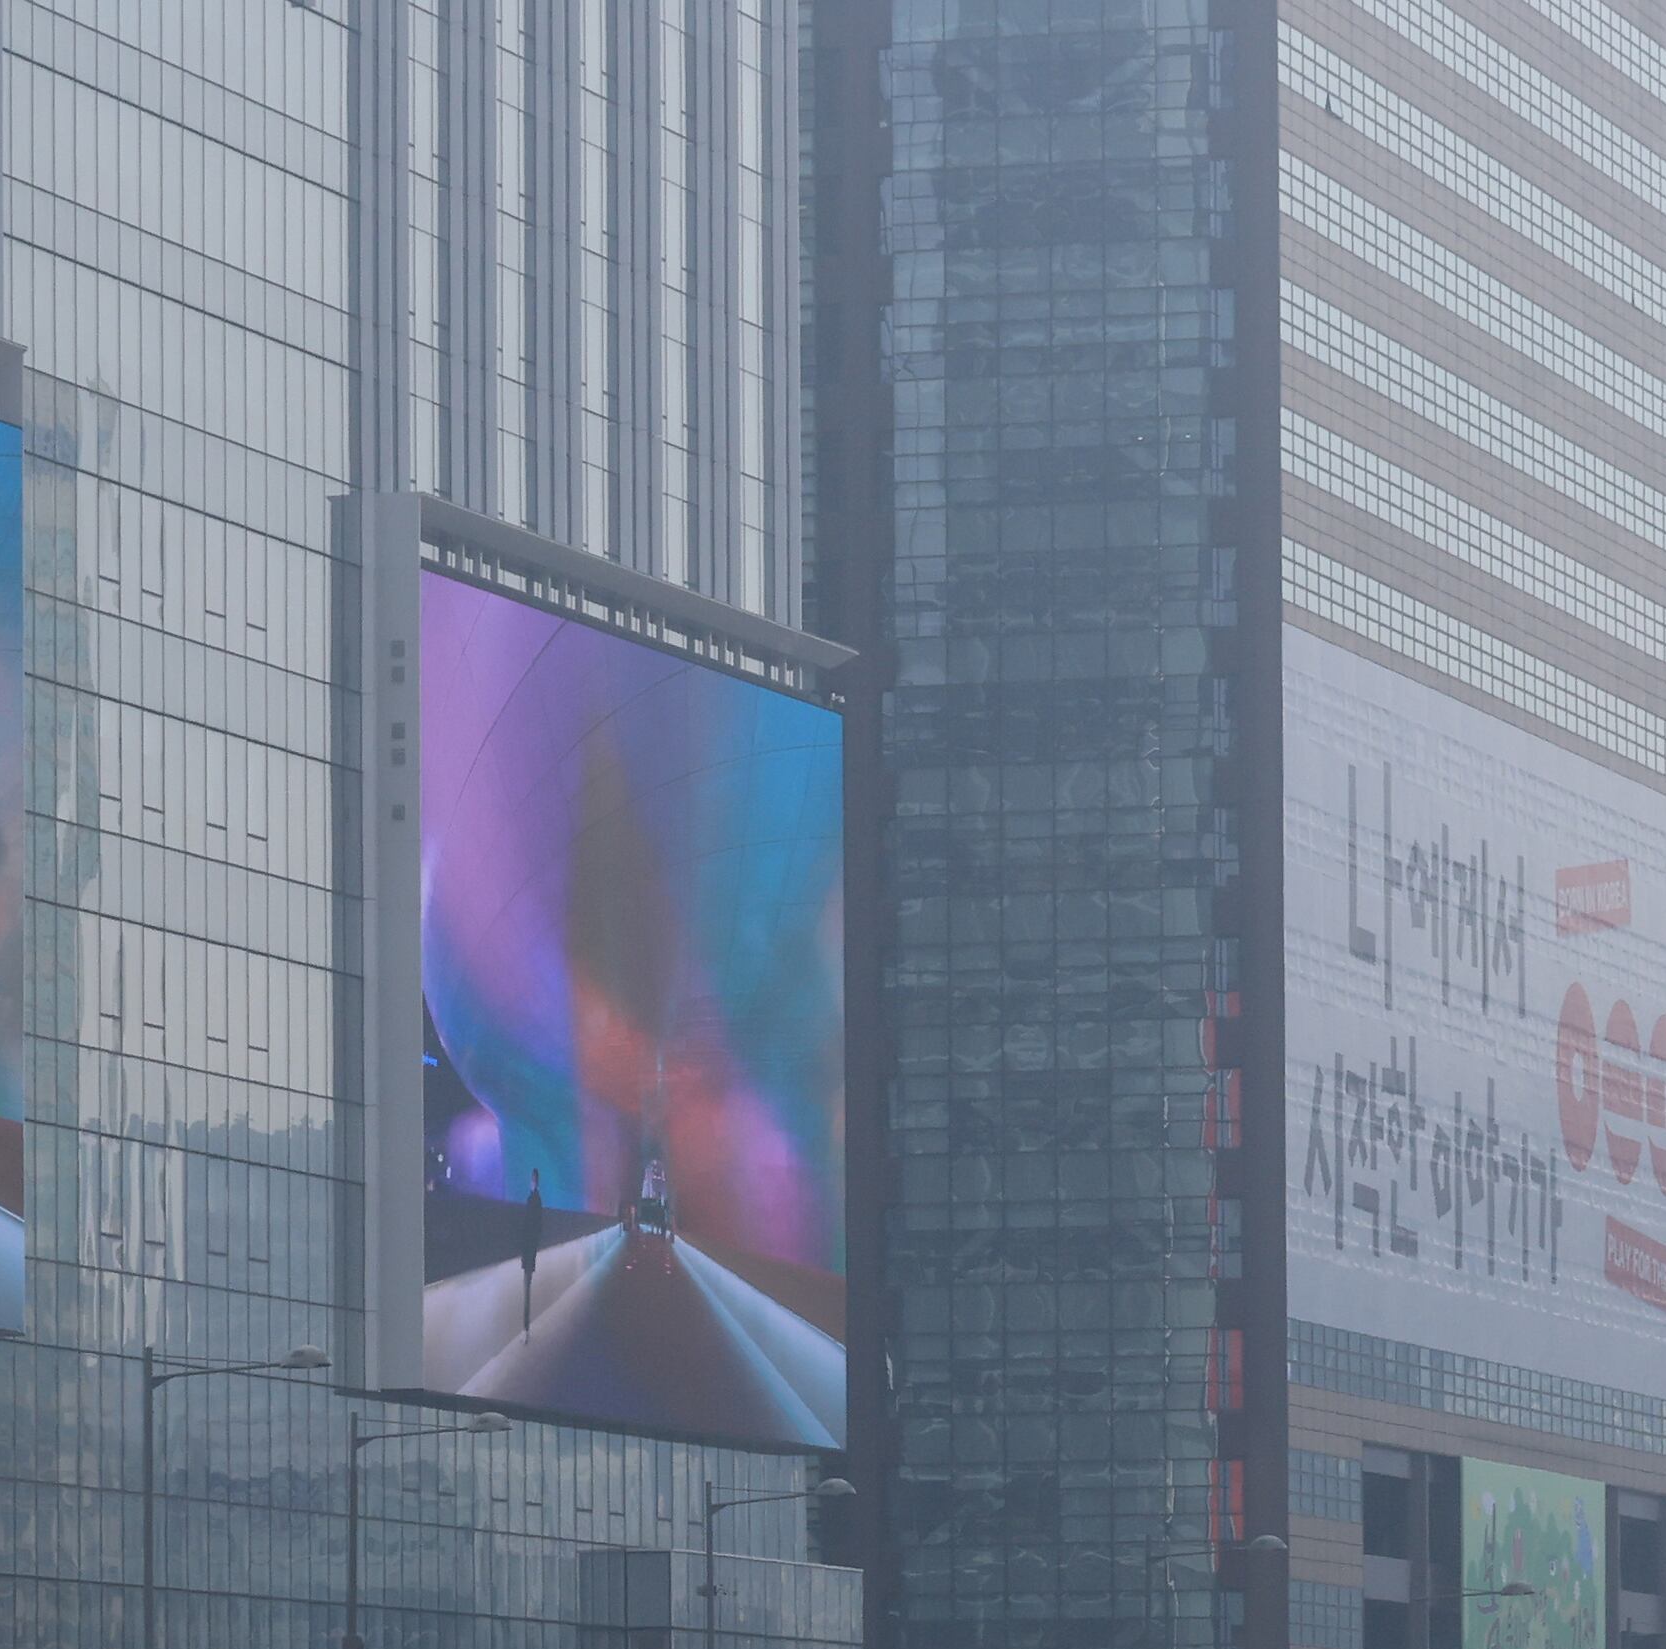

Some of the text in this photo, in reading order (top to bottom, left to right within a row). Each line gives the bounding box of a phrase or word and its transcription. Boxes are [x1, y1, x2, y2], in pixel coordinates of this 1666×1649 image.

[1346, 760, 1527, 1020] 나에게서
[1303, 1035, 1427, 1259] 시작한
[1430, 1076, 1564, 1287] 이야기가
[1607, 1232, 1631, 1272] PLAY
[1632, 1247, 1652, 1283] FOR
